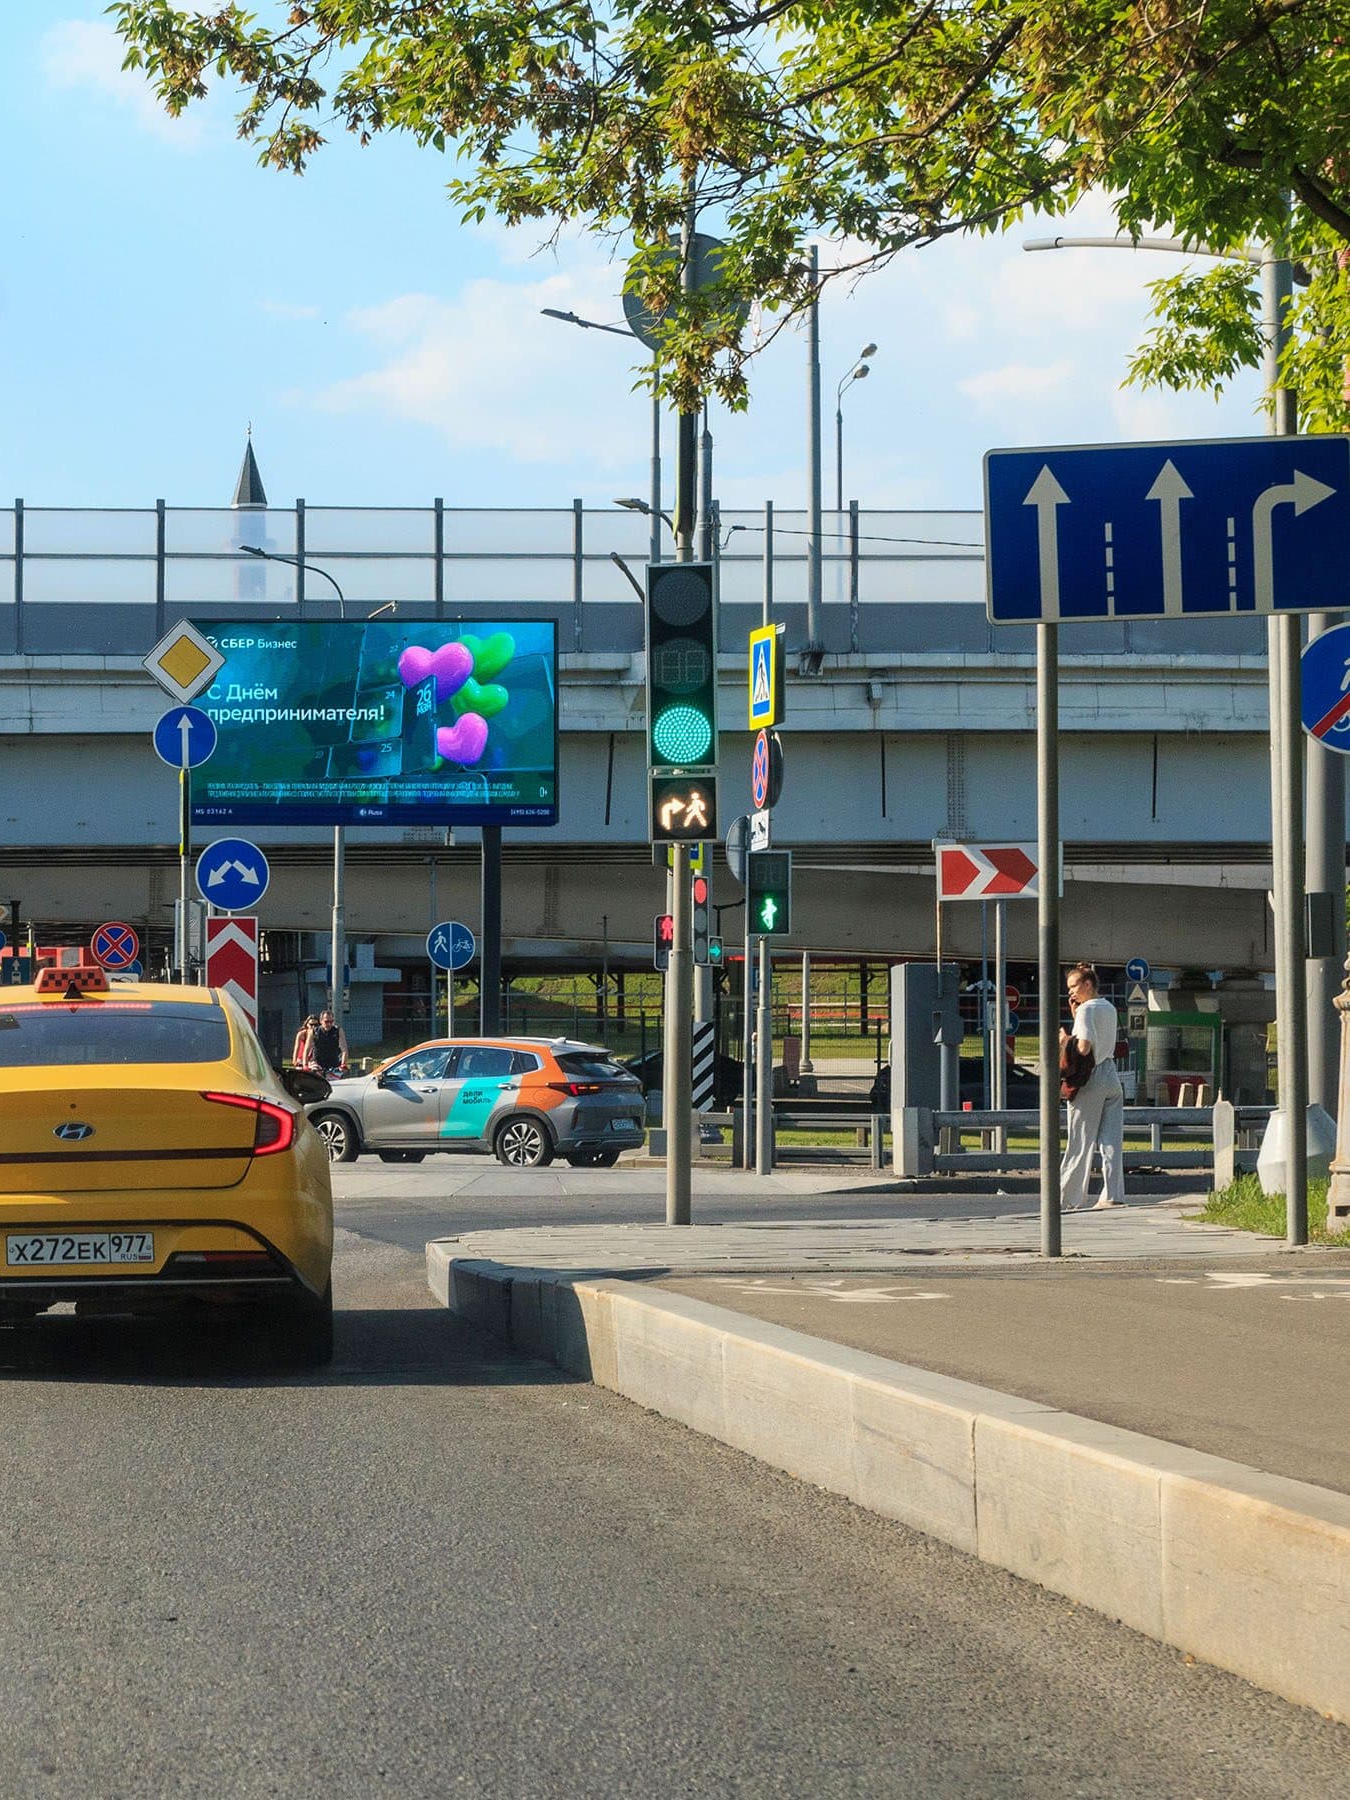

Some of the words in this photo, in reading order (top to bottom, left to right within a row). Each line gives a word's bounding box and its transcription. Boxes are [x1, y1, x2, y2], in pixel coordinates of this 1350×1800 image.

[220, 638, 255, 649] СБЕР
[257, 638, 298, 649] Бизнес
[207, 684, 222, 700] С
[225, 683, 278, 702] Днём
[417, 683, 432, 704] 26
[207, 705, 385, 725] предпринимателя!
[380, 743, 392, 753] 25
[111, 1235, 147, 1253] 977
